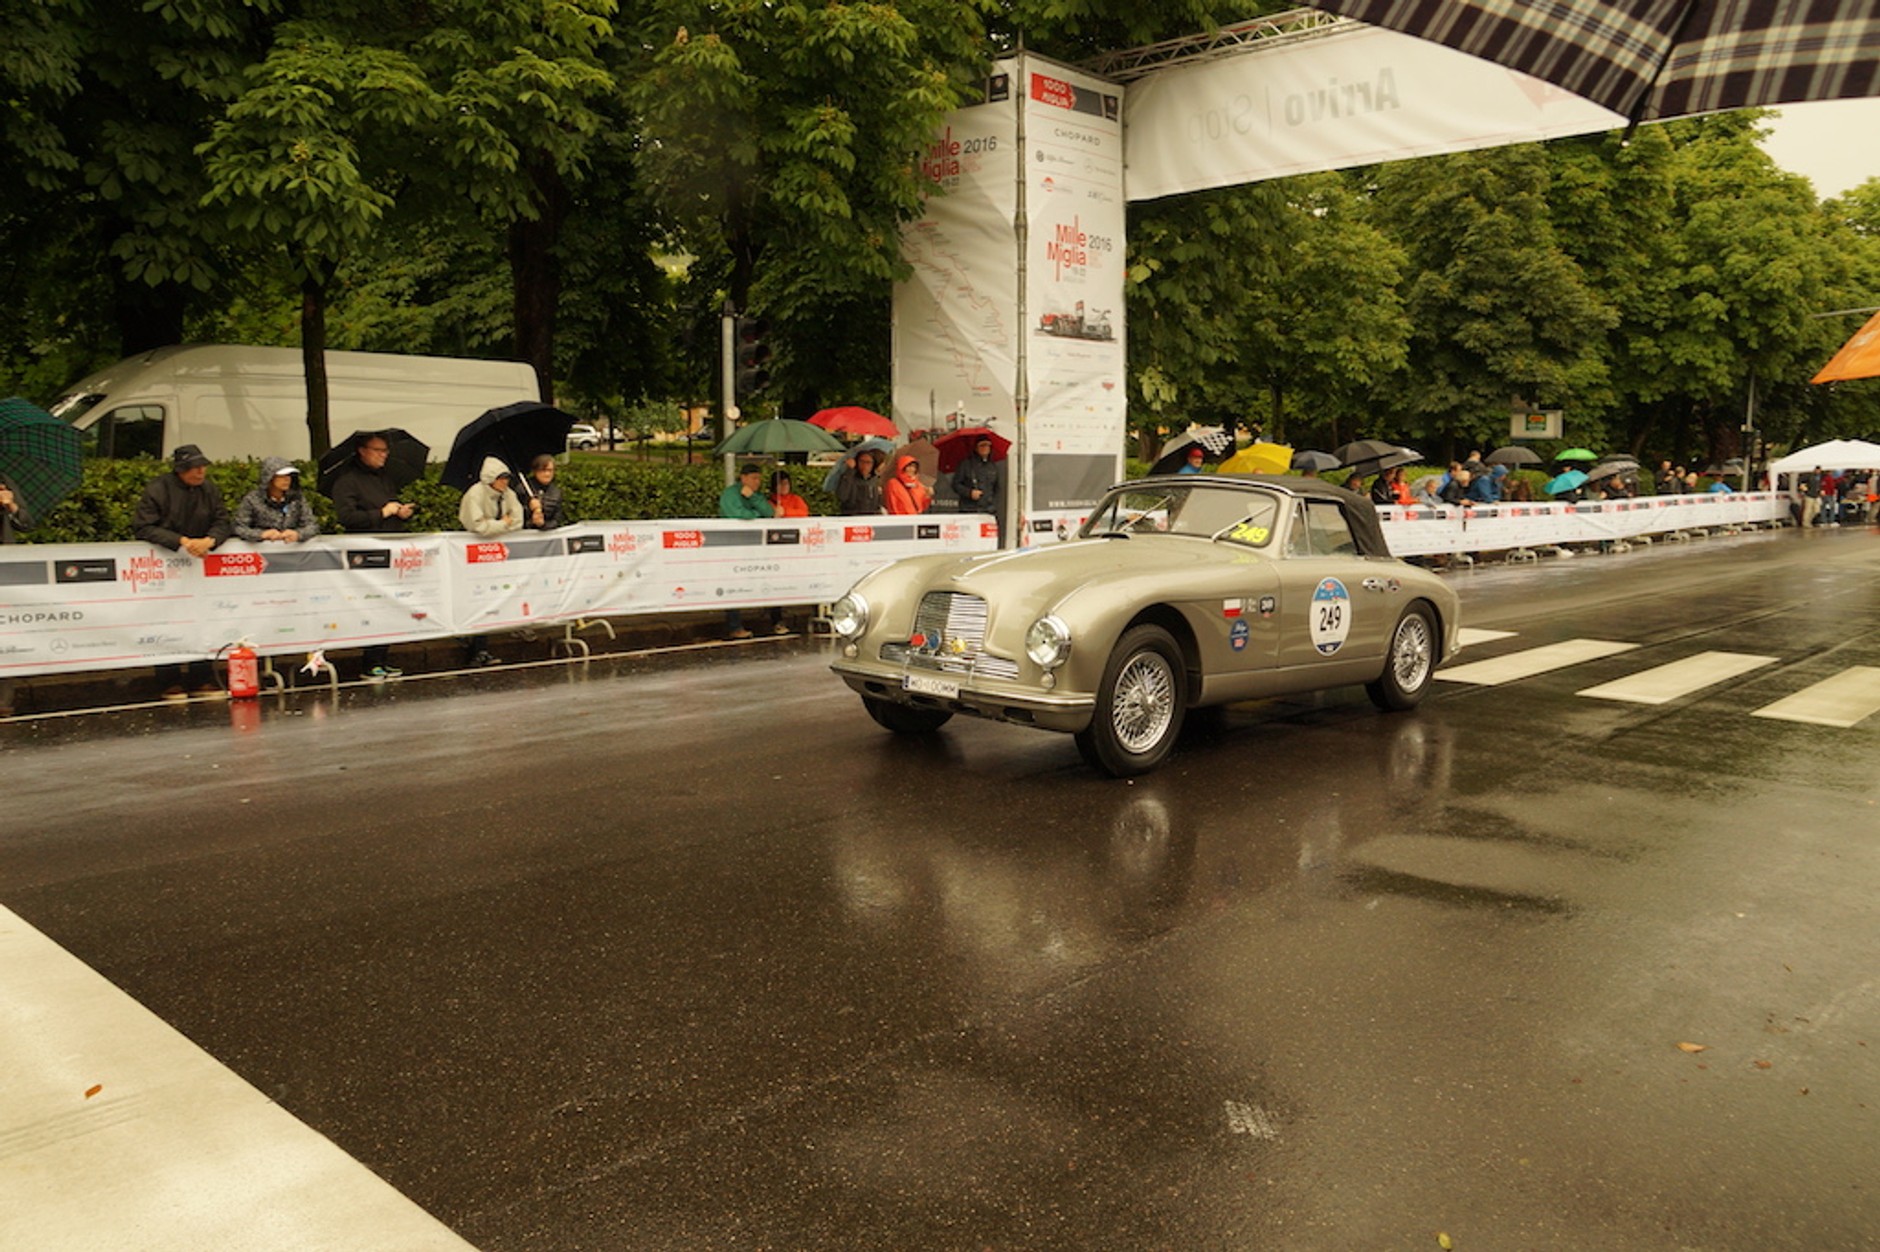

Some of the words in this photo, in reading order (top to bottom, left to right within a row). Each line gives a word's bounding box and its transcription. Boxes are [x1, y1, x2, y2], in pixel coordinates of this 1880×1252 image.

[1043, 79, 1067, 94] 1000
[963, 135, 997, 154] 2016
[1054, 128, 1100, 146] CHOPARD
[1055, 215, 1087, 248] Mille
[1088, 234, 1113, 252] 2016
[1047, 241, 1087, 282] Miglia
[1230, 523, 1270, 544] 249
[476, 543, 500, 552] 1000
[130, 549, 165, 570] Mille
[166, 556, 193, 568] 2016
[220, 554, 255, 565] 1000
[733, 563, 781, 574] CHOPARD
[220, 564, 258, 576] MIGLIA
[122, 568, 165, 593] Miglia
[1319, 605, 1342, 632] 249
